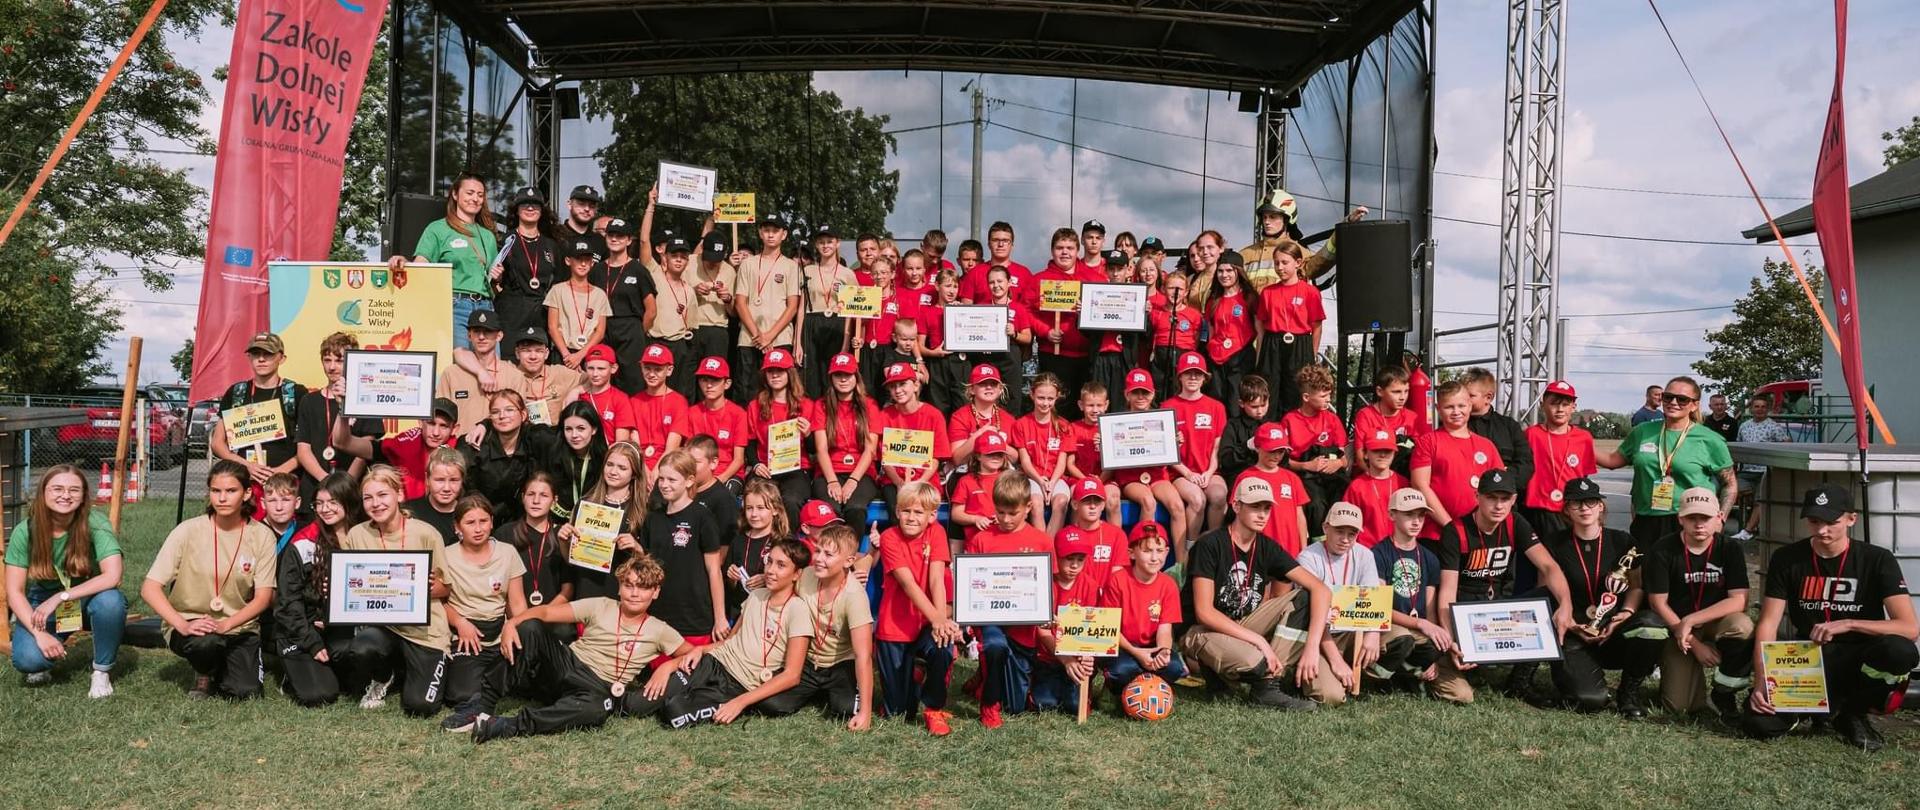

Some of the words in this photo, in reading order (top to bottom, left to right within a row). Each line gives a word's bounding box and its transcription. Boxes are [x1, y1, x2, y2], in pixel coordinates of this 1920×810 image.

[261, 11, 352, 72] Zakole
[256, 52, 344, 114] Dolnej
[251, 93, 331, 144] Wisły
[368, 299, 394, 308] Zakole
[368, 309, 394, 318] Dolnej
[376, 394, 396, 402] 1200
[233, 420, 248, 428] MDP
[250, 414, 276, 425] KIJEWO
[890, 443, 907, 452] MDP
[910, 445, 929, 454] GZIN
[585, 517, 610, 529] DYPLOM
[366, 600, 387, 609] 1200
[990, 600, 1011, 609] 1200
[1799, 600, 1863, 612] ProfiPower
[1340, 610, 1385, 620] RZĘCZKOWO
[1064, 626, 1084, 636] MDP
[1087, 624, 1117, 639] ŁĄŻYN
[1495, 641, 1515, 649] 1200
